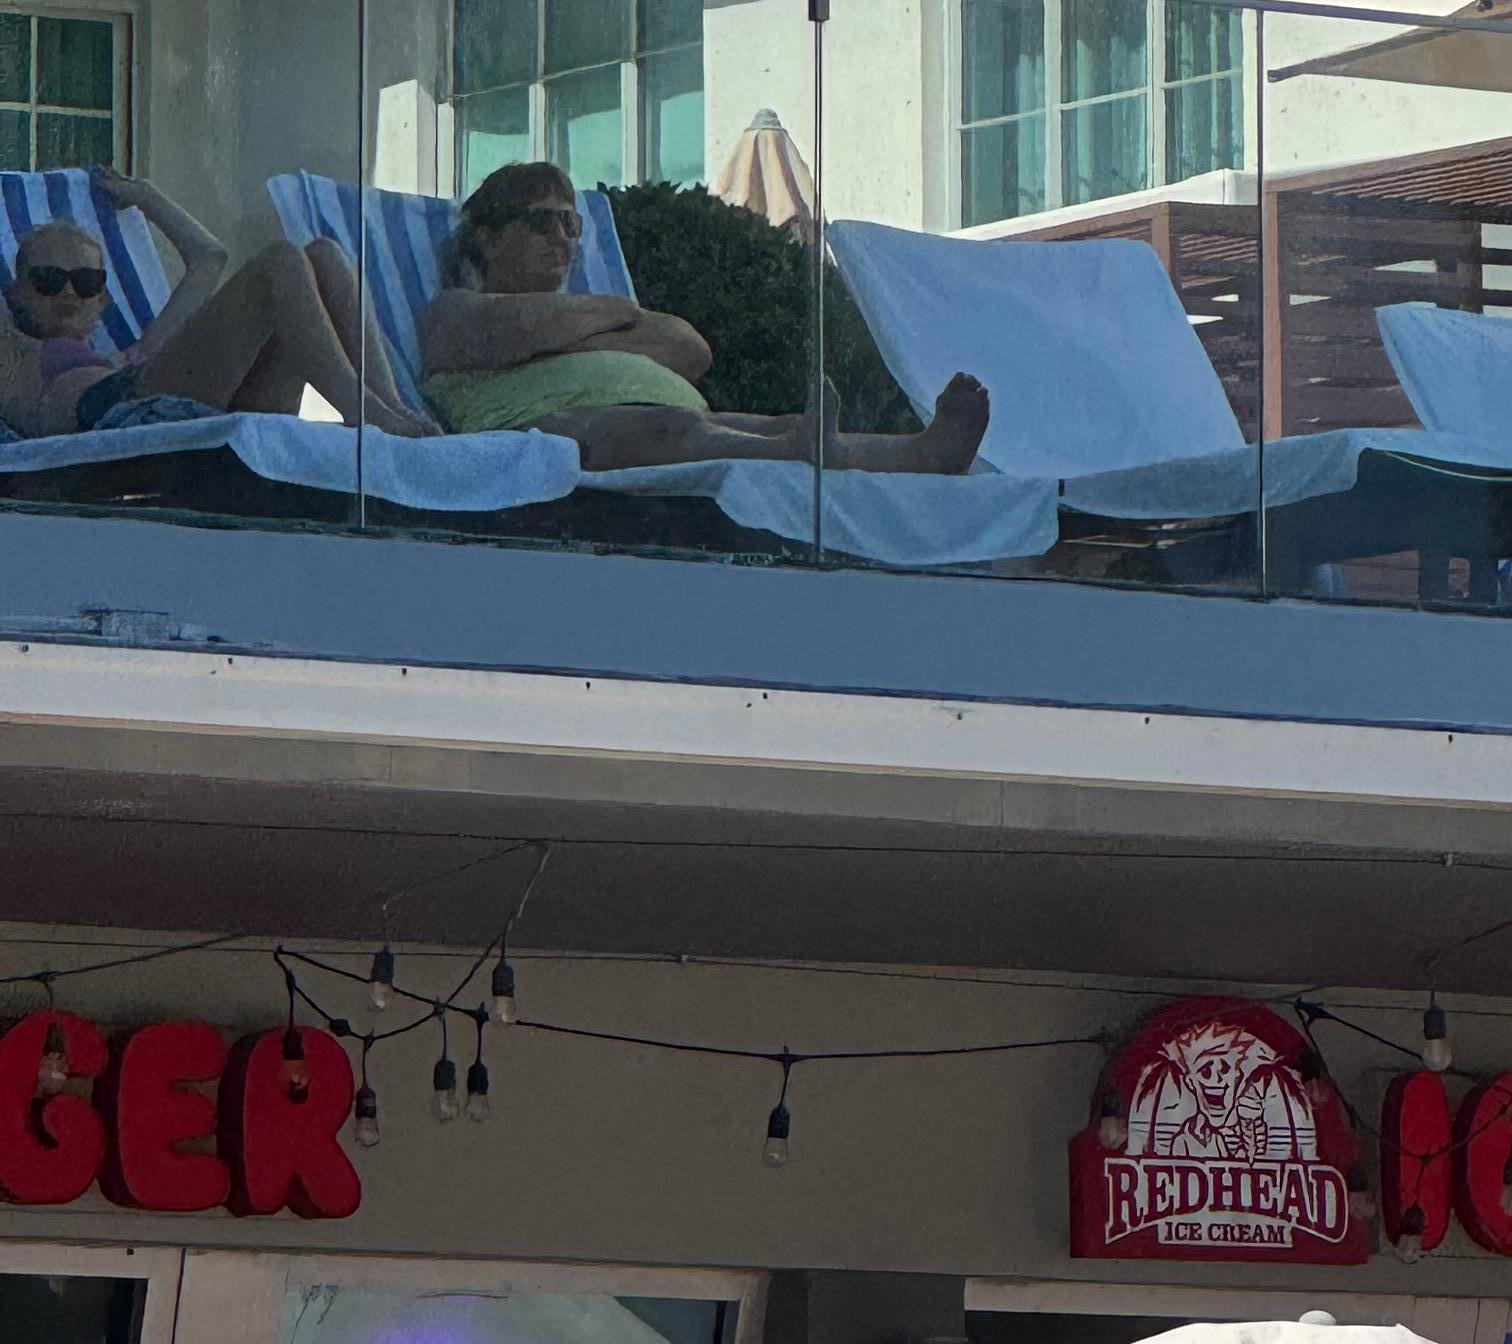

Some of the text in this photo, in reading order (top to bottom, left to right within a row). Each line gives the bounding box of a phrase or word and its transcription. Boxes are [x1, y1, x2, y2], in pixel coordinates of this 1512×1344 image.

[1105, 1158, 1348, 1244] REDHEAD
[1164, 1221, 1286, 1244] ICE CREAM
